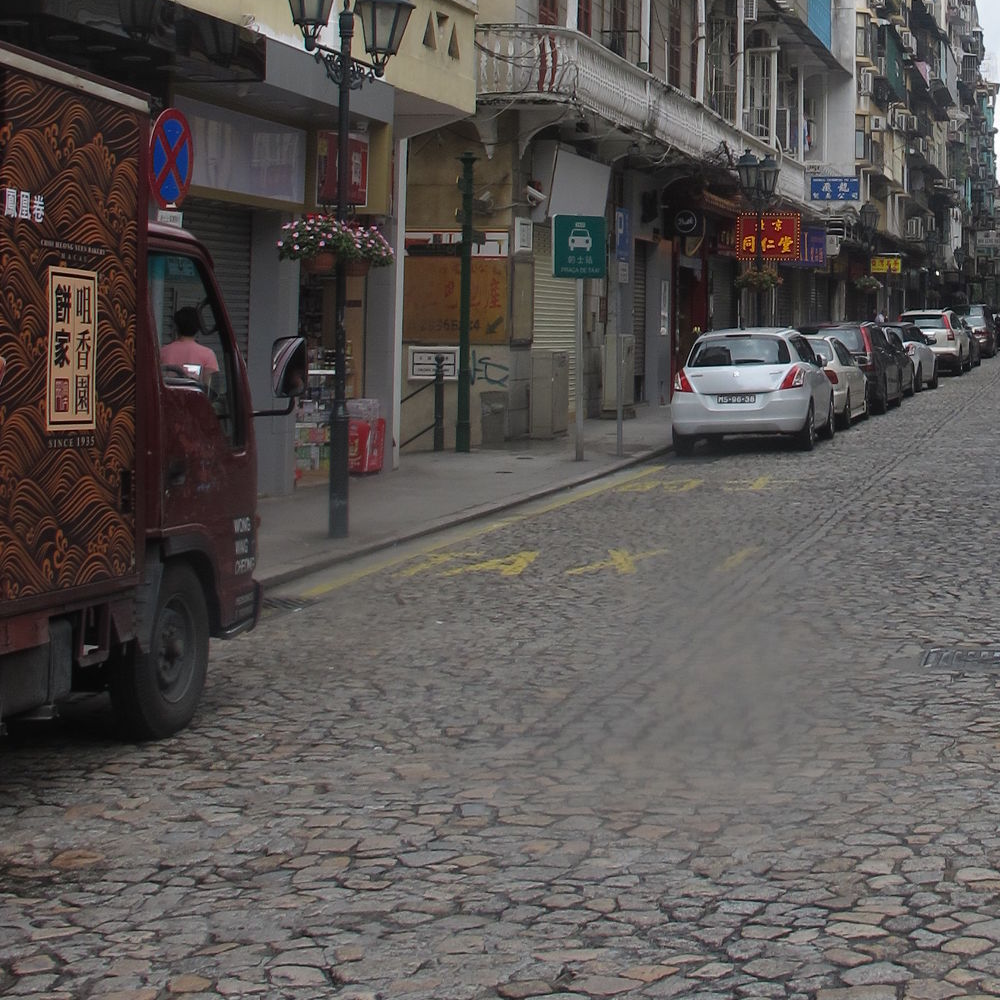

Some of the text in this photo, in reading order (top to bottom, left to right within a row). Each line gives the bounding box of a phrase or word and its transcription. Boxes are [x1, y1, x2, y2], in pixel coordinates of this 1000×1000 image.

[742, 235, 794, 254] 同仁堂
[54, 283, 72, 368] 餅家
[75, 285, 92, 415] 咀香園
[48, 436, 95, 448] SINCE 1935
